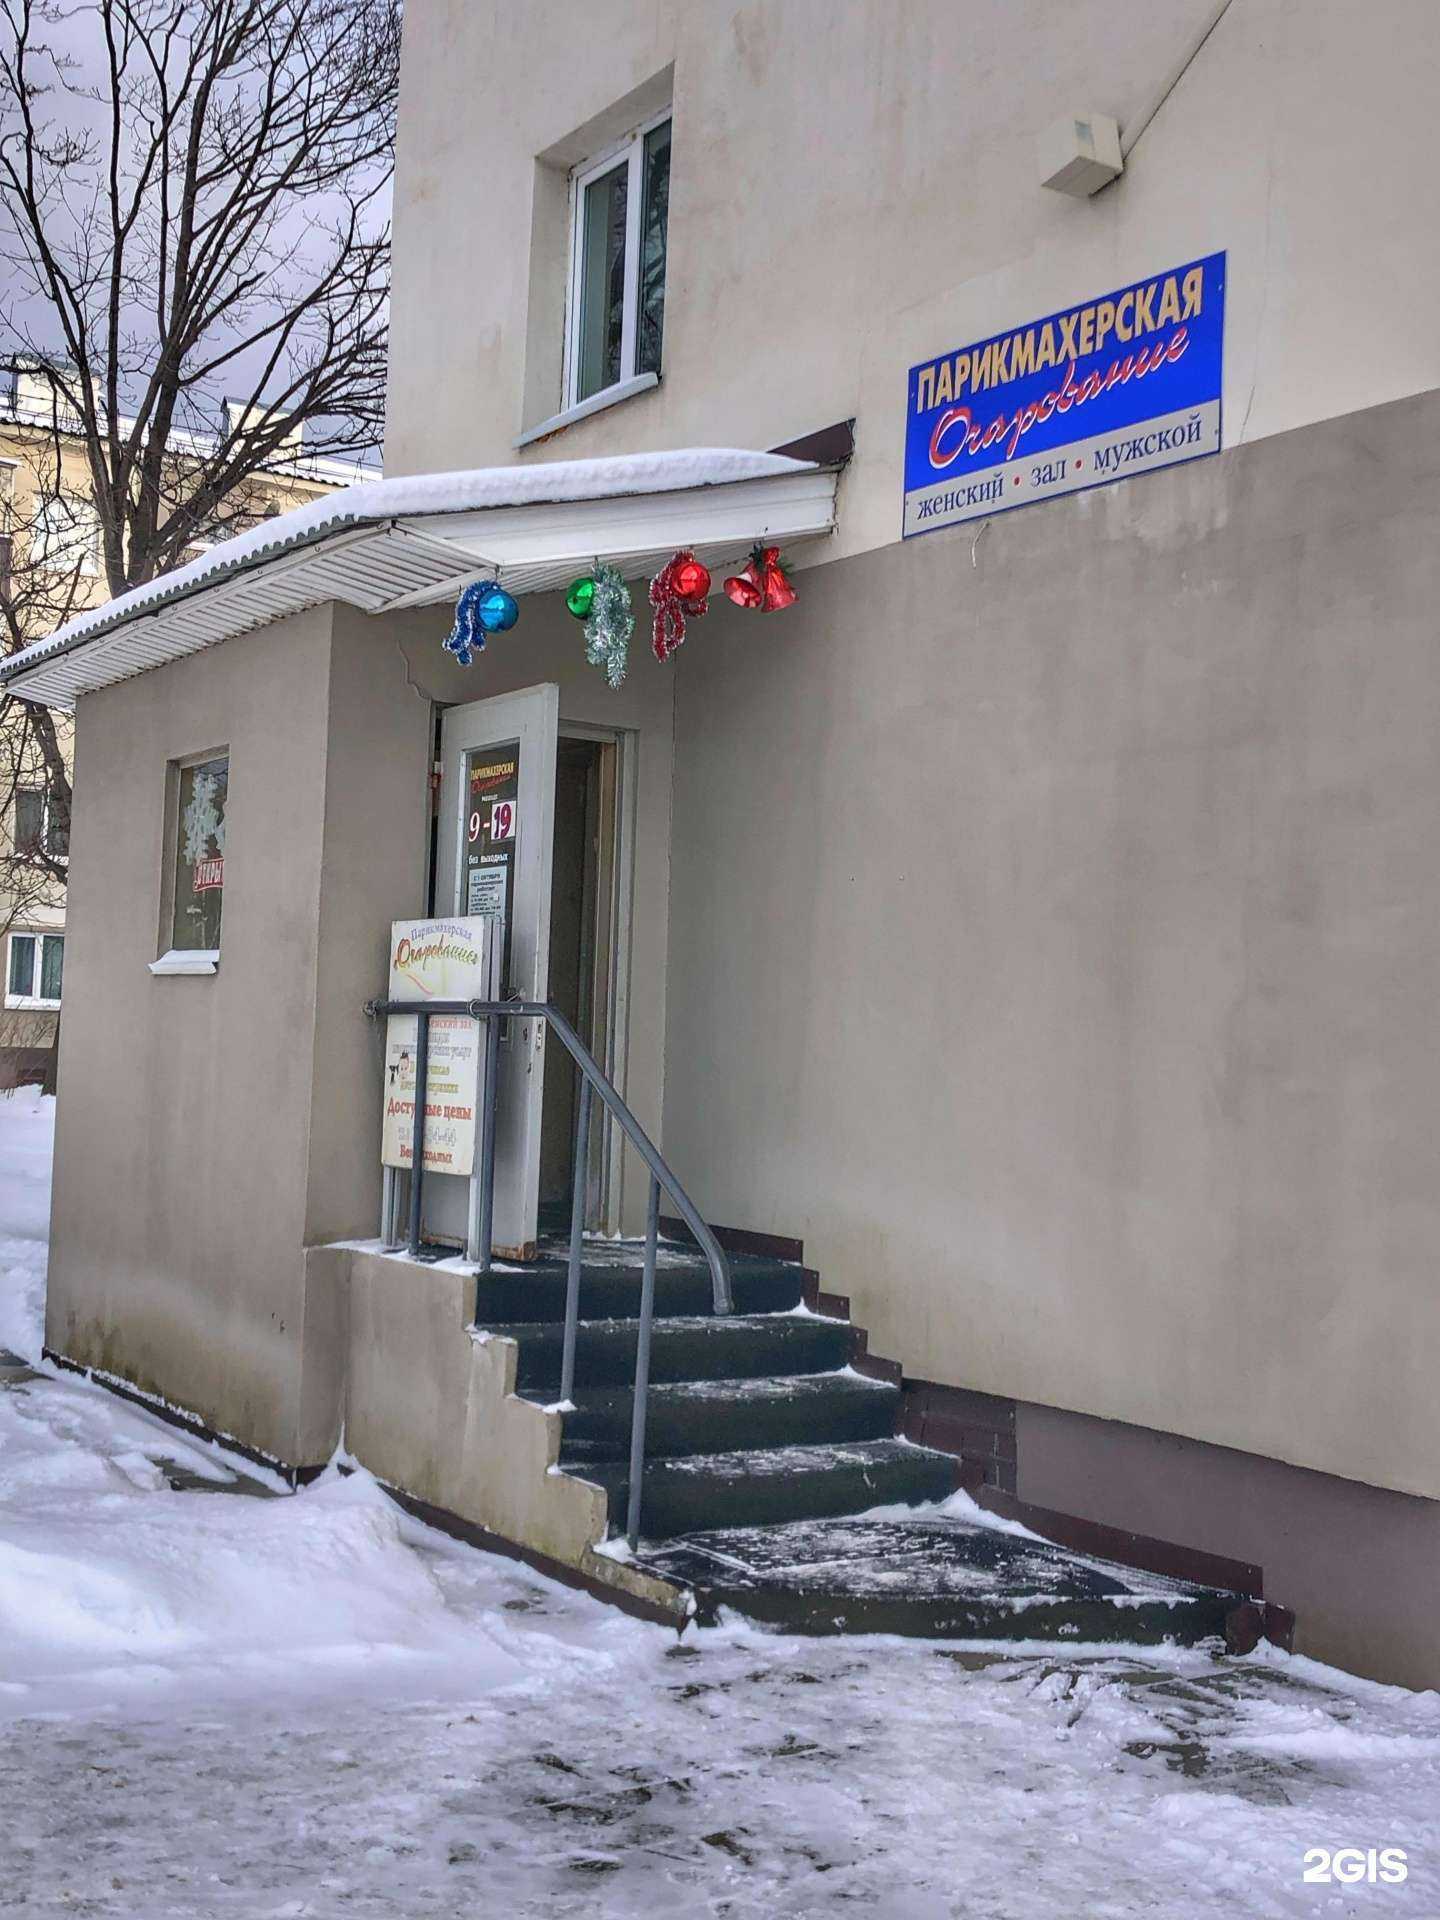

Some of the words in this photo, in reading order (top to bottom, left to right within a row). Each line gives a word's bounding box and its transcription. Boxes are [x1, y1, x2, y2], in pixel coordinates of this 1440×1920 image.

[916, 266, 1204, 415] ПАРИКМАХЕРСКАЯ
[928, 325, 1190, 469] Очарование
[917, 473, 1004, 520] женский
[1030, 459, 1066, 488] зал
[1093, 413, 1202, 474] мужской
[387, 1096, 443, 1119] Достуные
[444, 1105, 472, 1121] цены
